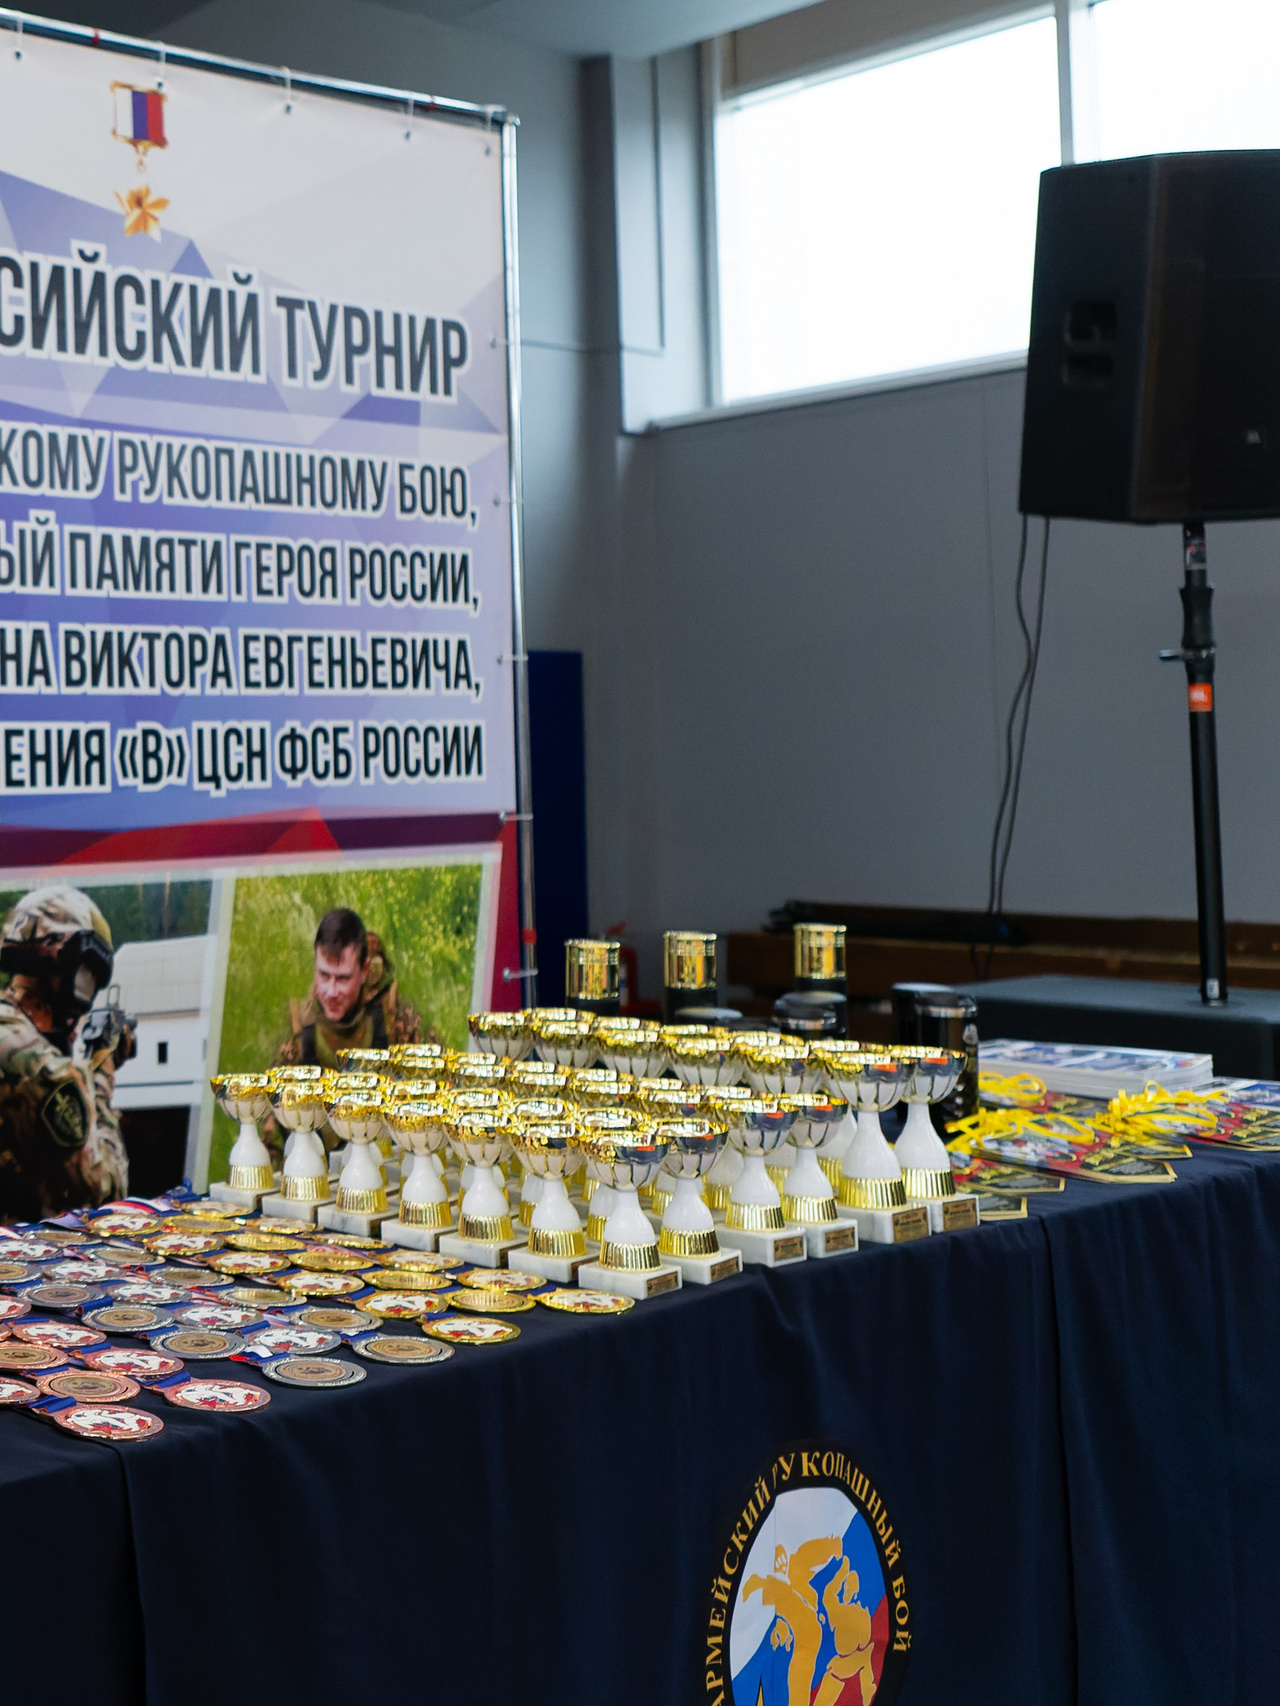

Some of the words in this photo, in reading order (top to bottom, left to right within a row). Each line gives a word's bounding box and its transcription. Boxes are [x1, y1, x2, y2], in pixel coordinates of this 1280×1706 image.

[276, 296, 467, 396] ТУРНИР
[119, 439, 388, 512] РУКОПАШНОМУ
[400, 463, 477, 526] БОЮ,
[69, 532, 222, 593] ПАМЯТИ
[234, 542, 337, 598] ГЕРОЯ
[350, 548, 478, 611] РОССИИ,
[65, 630, 232, 689] ВИКТОРА
[244, 634, 480, 697] ЕВГЕНЬЕВИЧА,
[120, 727, 186, 786] «В»
[197, 727, 267, 789] ЦСН
[279, 726, 352, 780] ФСБ
[363, 725, 483, 778] РОССИИ
[892, 1574, 913, 1652] БОЙ
